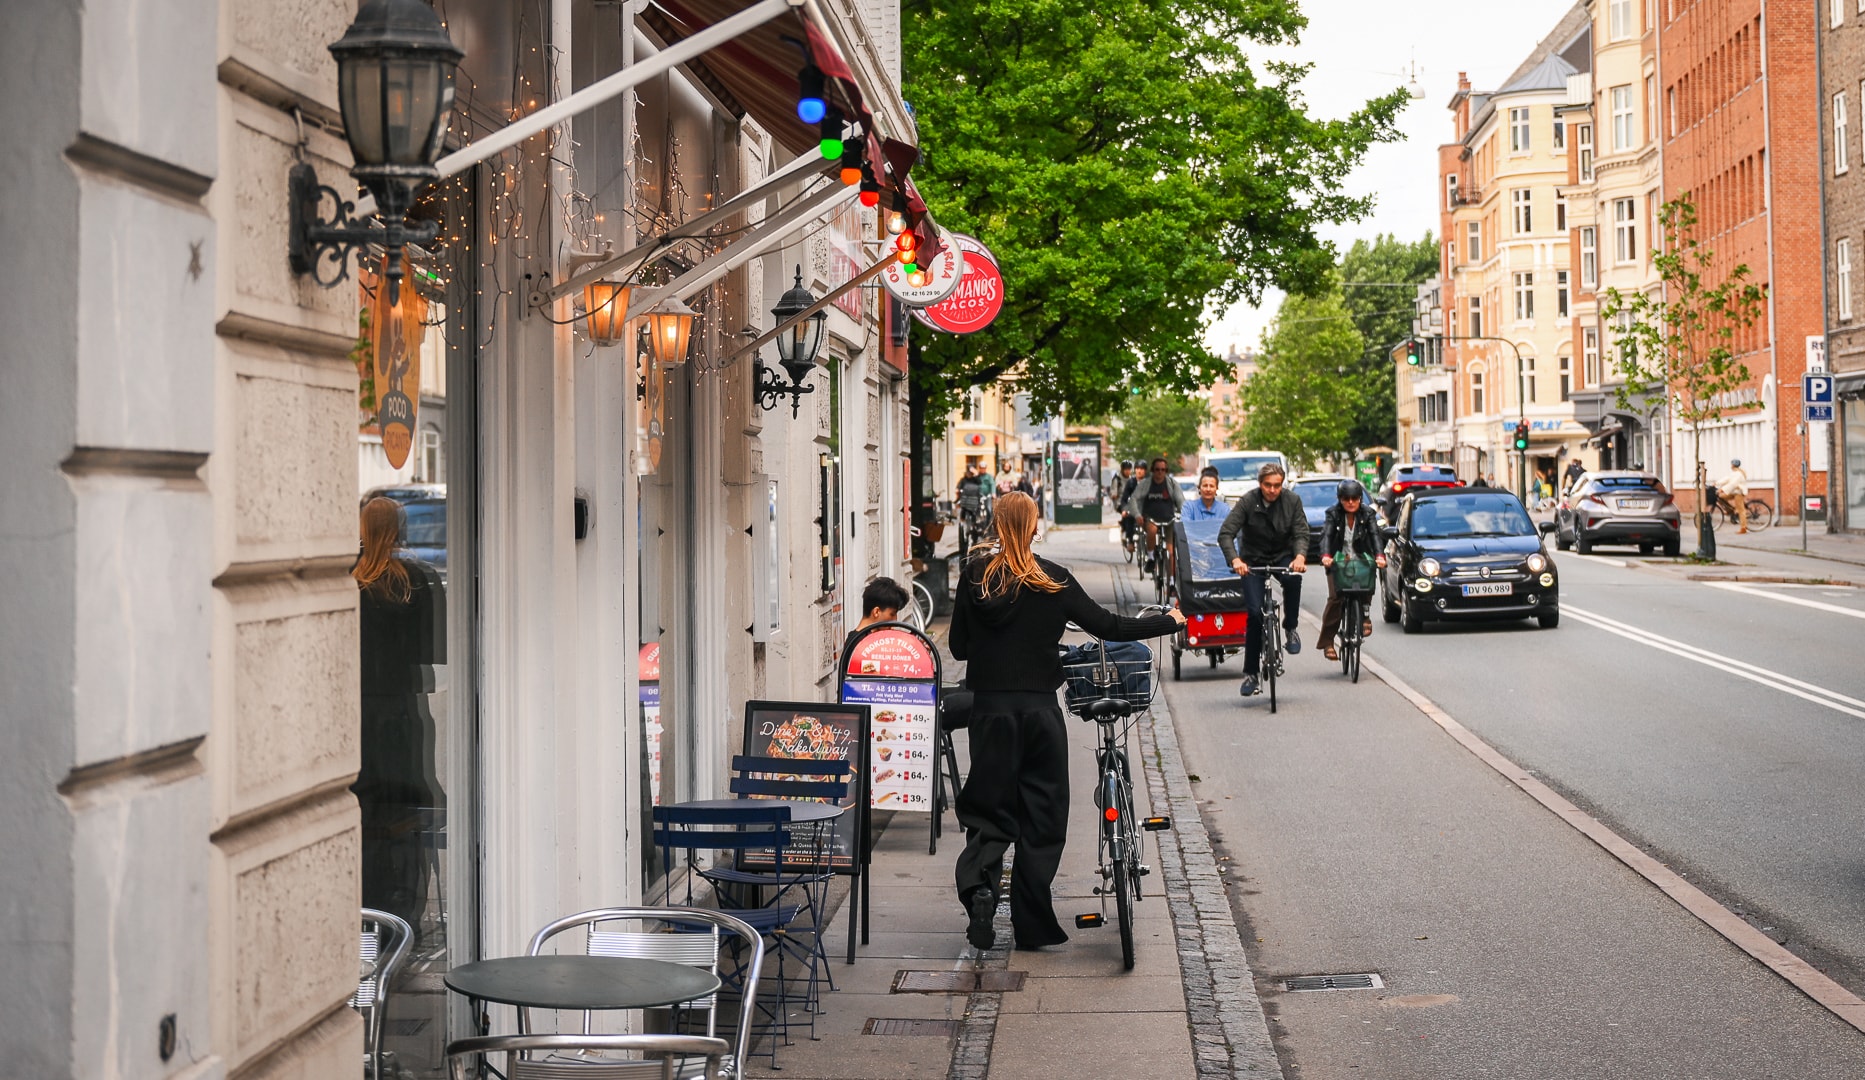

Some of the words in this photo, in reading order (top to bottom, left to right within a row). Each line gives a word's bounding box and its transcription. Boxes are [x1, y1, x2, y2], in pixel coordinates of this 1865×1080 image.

[941, 297, 985, 311] TACOS
[1811, 378, 1828, 401] P
[388, 396, 407, 420] POCO
[1468, 585, 1480, 595] DV
[1482, 585, 1493, 594] 96
[1494, 584, 1510, 593] 989
[861, 638, 895, 658] FROKOST
[897, 638, 921, 660] TILBUD
[871, 653, 892, 661] BERLIN
[903, 664, 921, 675] 74,-
[876, 685, 886, 693] 42
[887, 685, 897, 693] 16
[908, 686, 919, 694] 90
[913, 714, 930, 723] 49,-
[760, 721, 793, 739] Dine
[795, 726, 809, 737] in
[812, 724, 823, 737] &
[912, 733, 929, 741] 59,-
[911, 750, 929, 760] 64,-
[910, 771, 928, 781] 64,-
[910, 795, 927, 804] 39,-
